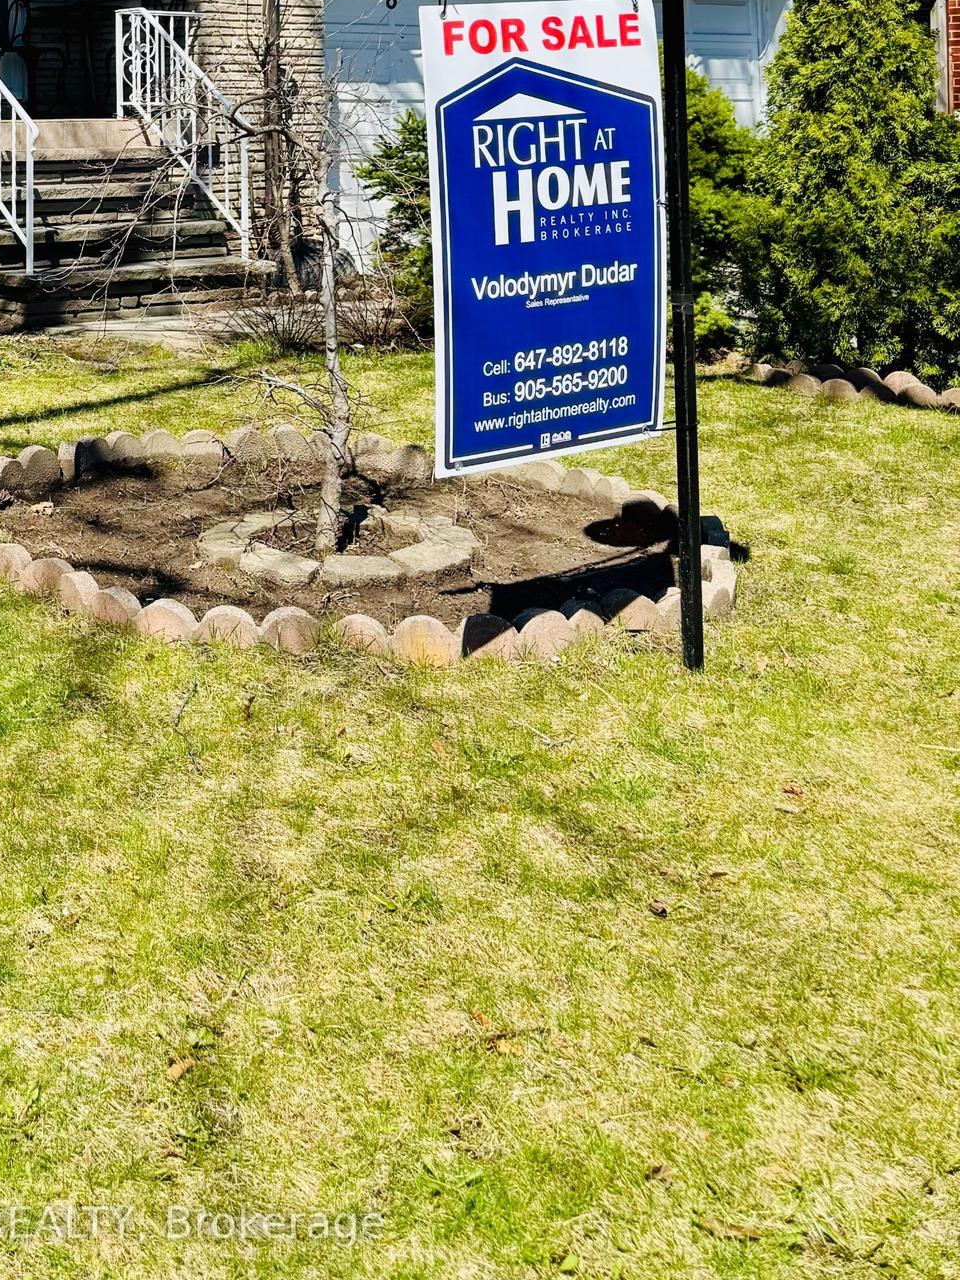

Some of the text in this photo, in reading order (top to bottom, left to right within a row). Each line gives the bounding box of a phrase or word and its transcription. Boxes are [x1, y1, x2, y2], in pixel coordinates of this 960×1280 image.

[443, 13, 642, 56] FOR SALE
[472, 118, 616, 169] RIGHT AT
[492, 160, 631, 246] HOME
[540, 208, 632, 227] REALTY INC.
[540, 221, 632, 242] BROKERAGE
[471, 260, 638, 300] Volodymyr Dudar
[525, 293, 590, 309] Sales Representative
[483, 336, 628, 377] Cell: 647-892-8118
[483, 365, 628, 407] Bus: 905-565-9200
[474, 393, 636, 433] www.rightathomerealty.com
